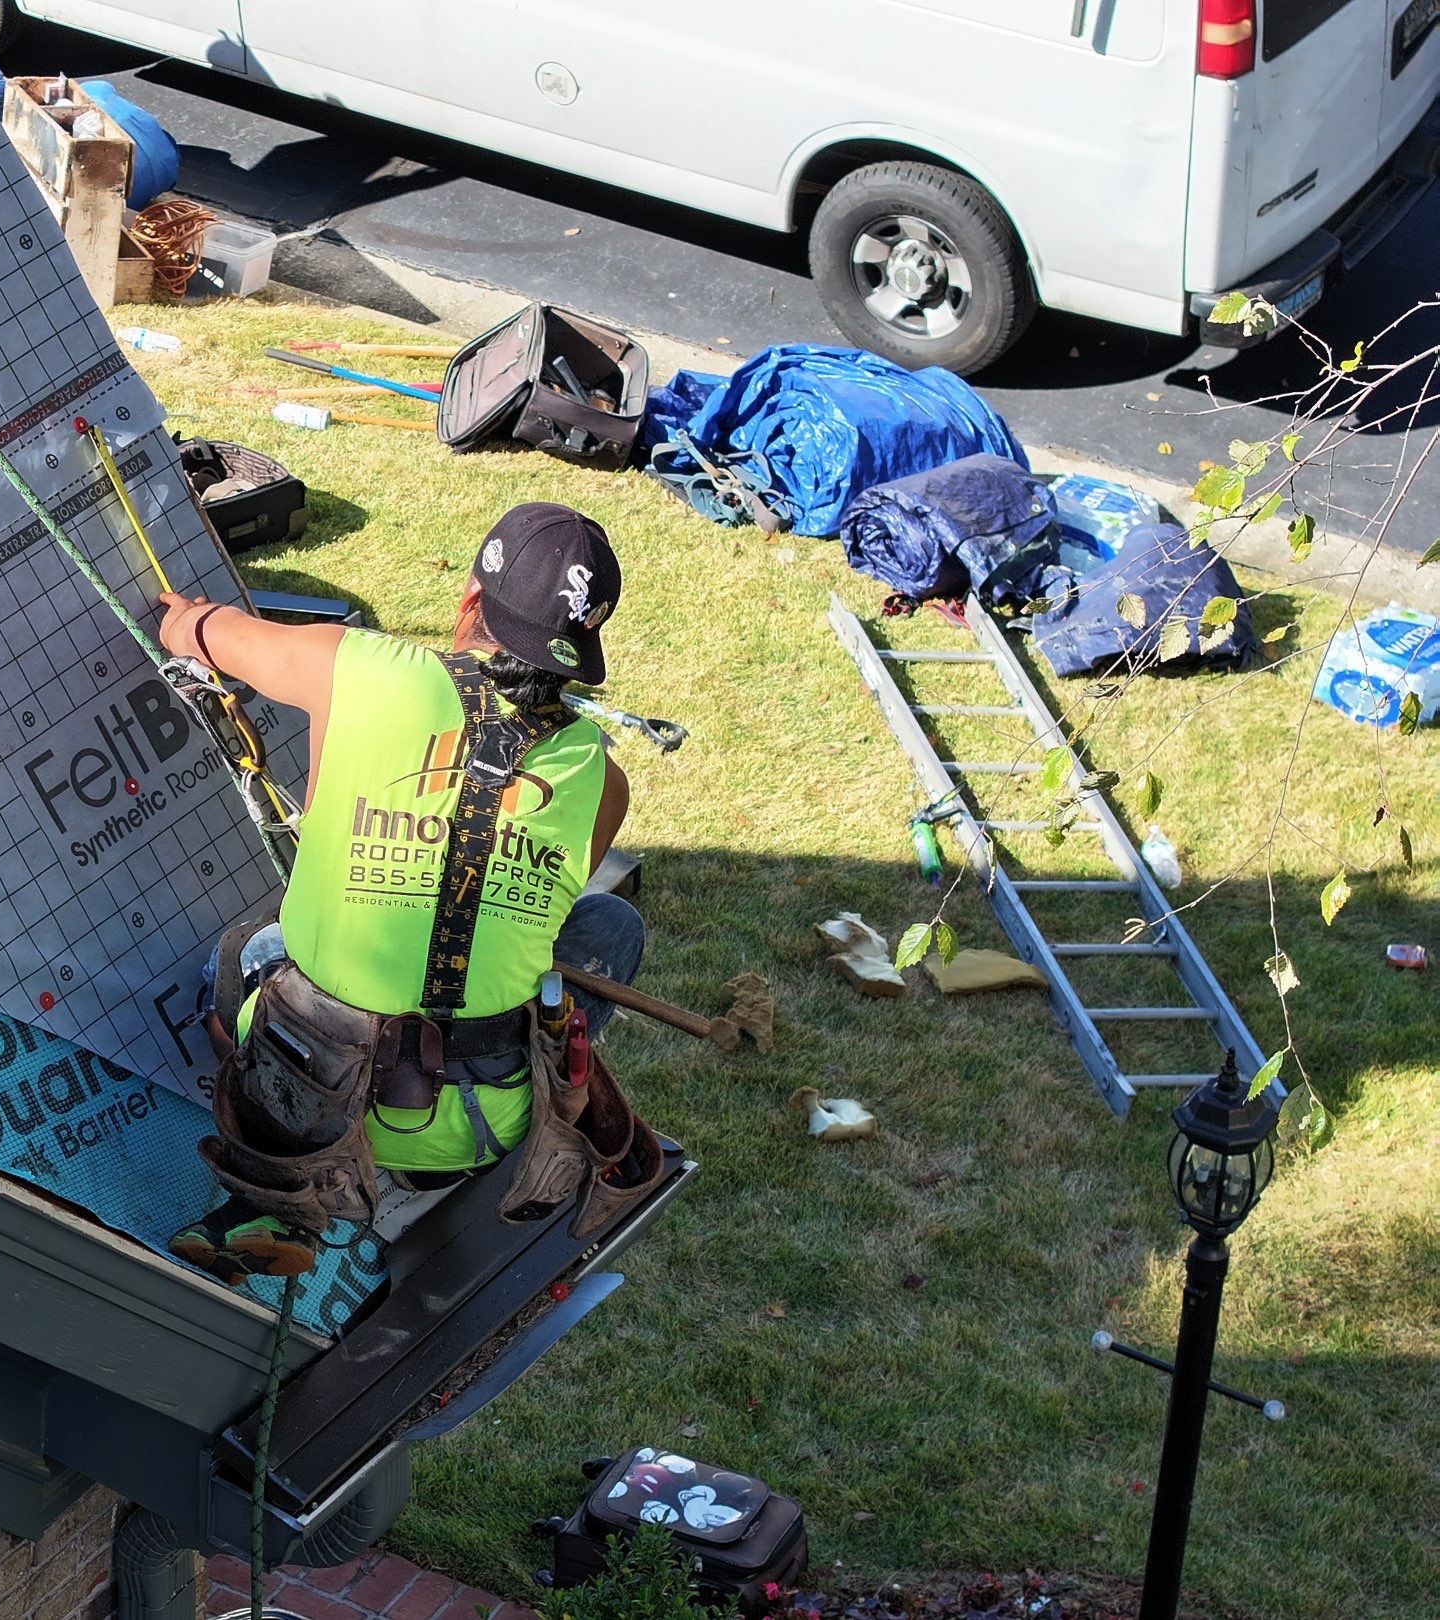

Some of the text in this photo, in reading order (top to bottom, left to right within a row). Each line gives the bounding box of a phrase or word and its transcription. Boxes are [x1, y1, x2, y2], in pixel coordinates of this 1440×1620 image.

[70, 788, 166, 867] Synthetic
[254, 704, 280, 737] elt
[352, 796, 567, 880] Innotive
[345, 896, 418, 909] RESIDENTIAL
[491, 861, 554, 892] PROS
[511, 915, 548, 929] ROOFING
[52, 1082, 158, 1160] Barrier
